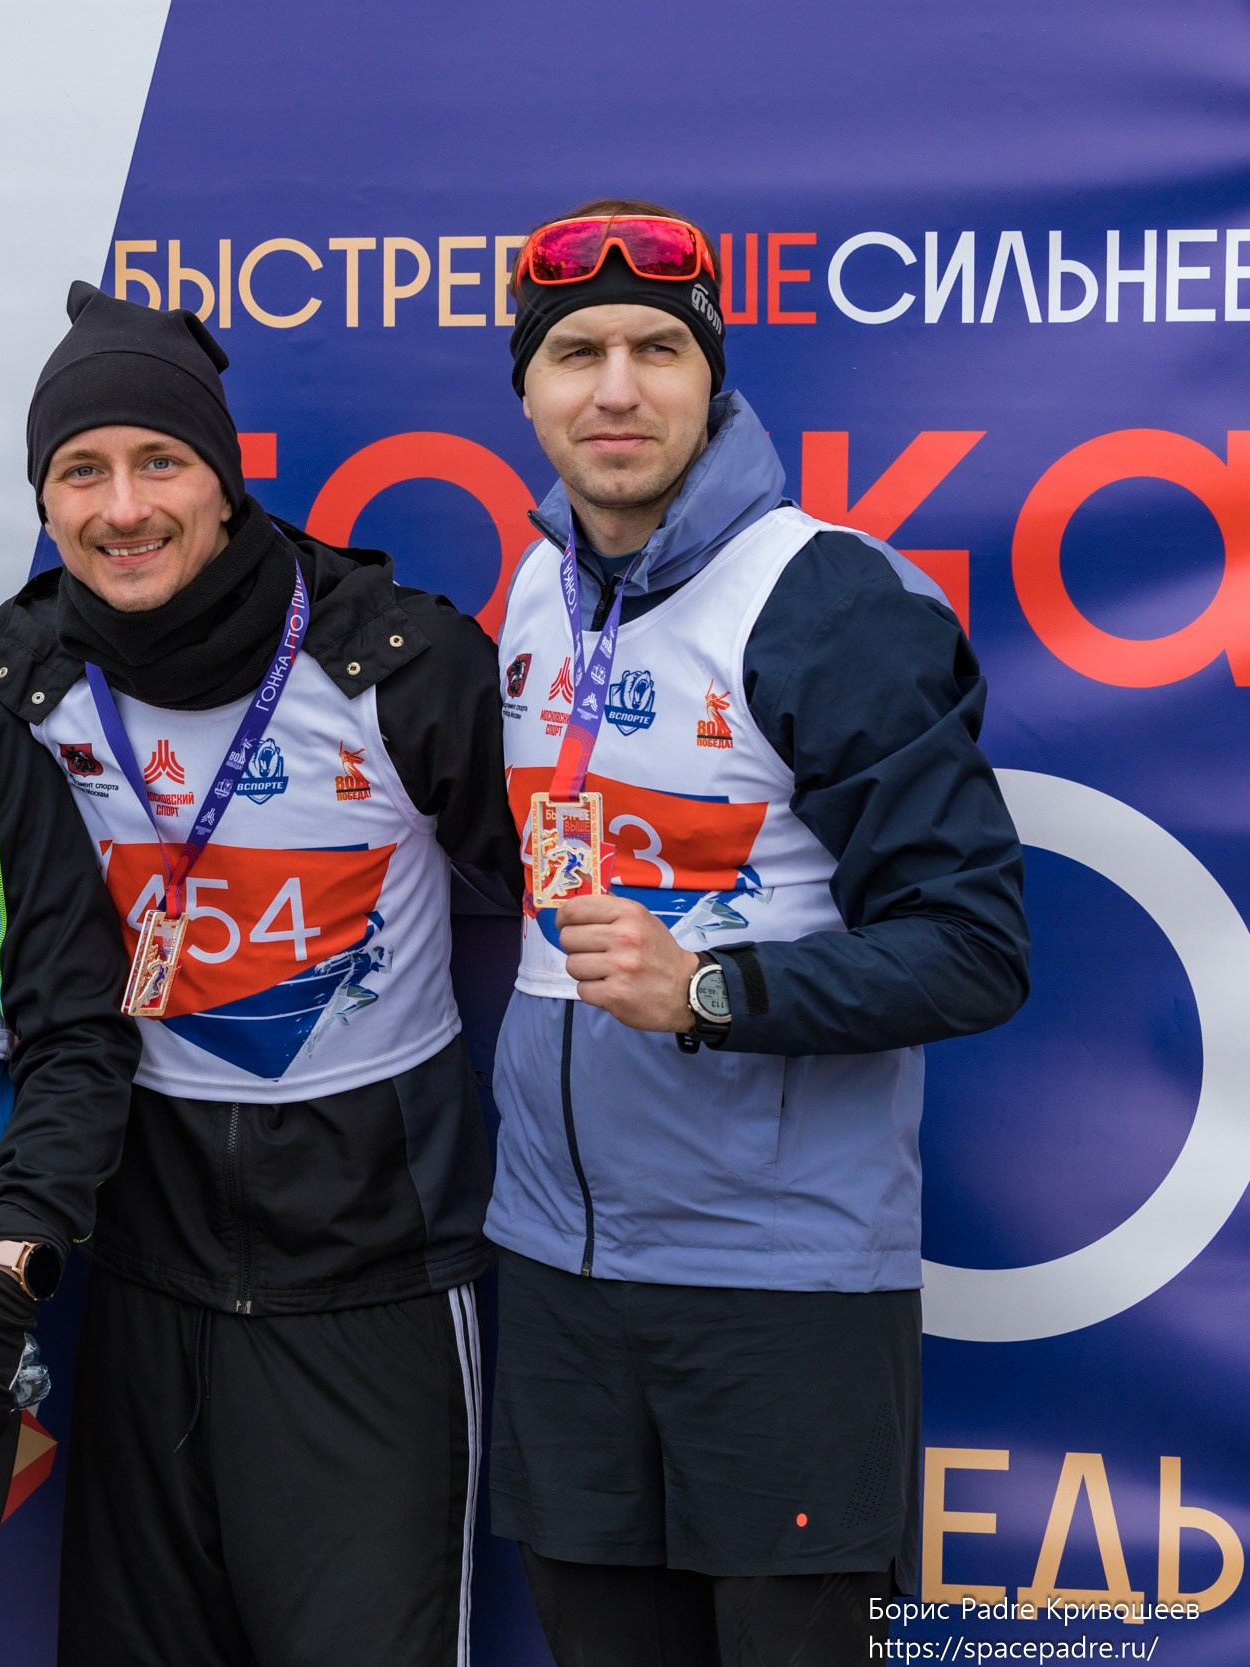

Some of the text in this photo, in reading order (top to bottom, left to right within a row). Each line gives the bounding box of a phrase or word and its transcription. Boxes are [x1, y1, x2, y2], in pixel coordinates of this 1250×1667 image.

[719, 232, 817, 325] ШЕ
[256, 654, 291, 711] ГОНКА
[284, 613, 305, 649] ГТО
[608, 711, 651, 724] ВСПОРТЕ
[697, 720, 713, 736] 80
[697, 737, 734, 749] ПОБЕДА!
[95, 783, 119, 792] спорта
[236, 780, 283, 791] ВСПОРТЕ
[335, 775, 352, 790] 80
[336, 790, 372, 801] ПОБЕДА!
[156, 805, 179, 818] СПОРТ
[564, 821, 590, 833] ВЫШЕ
[127, 873, 321, 965] 454
